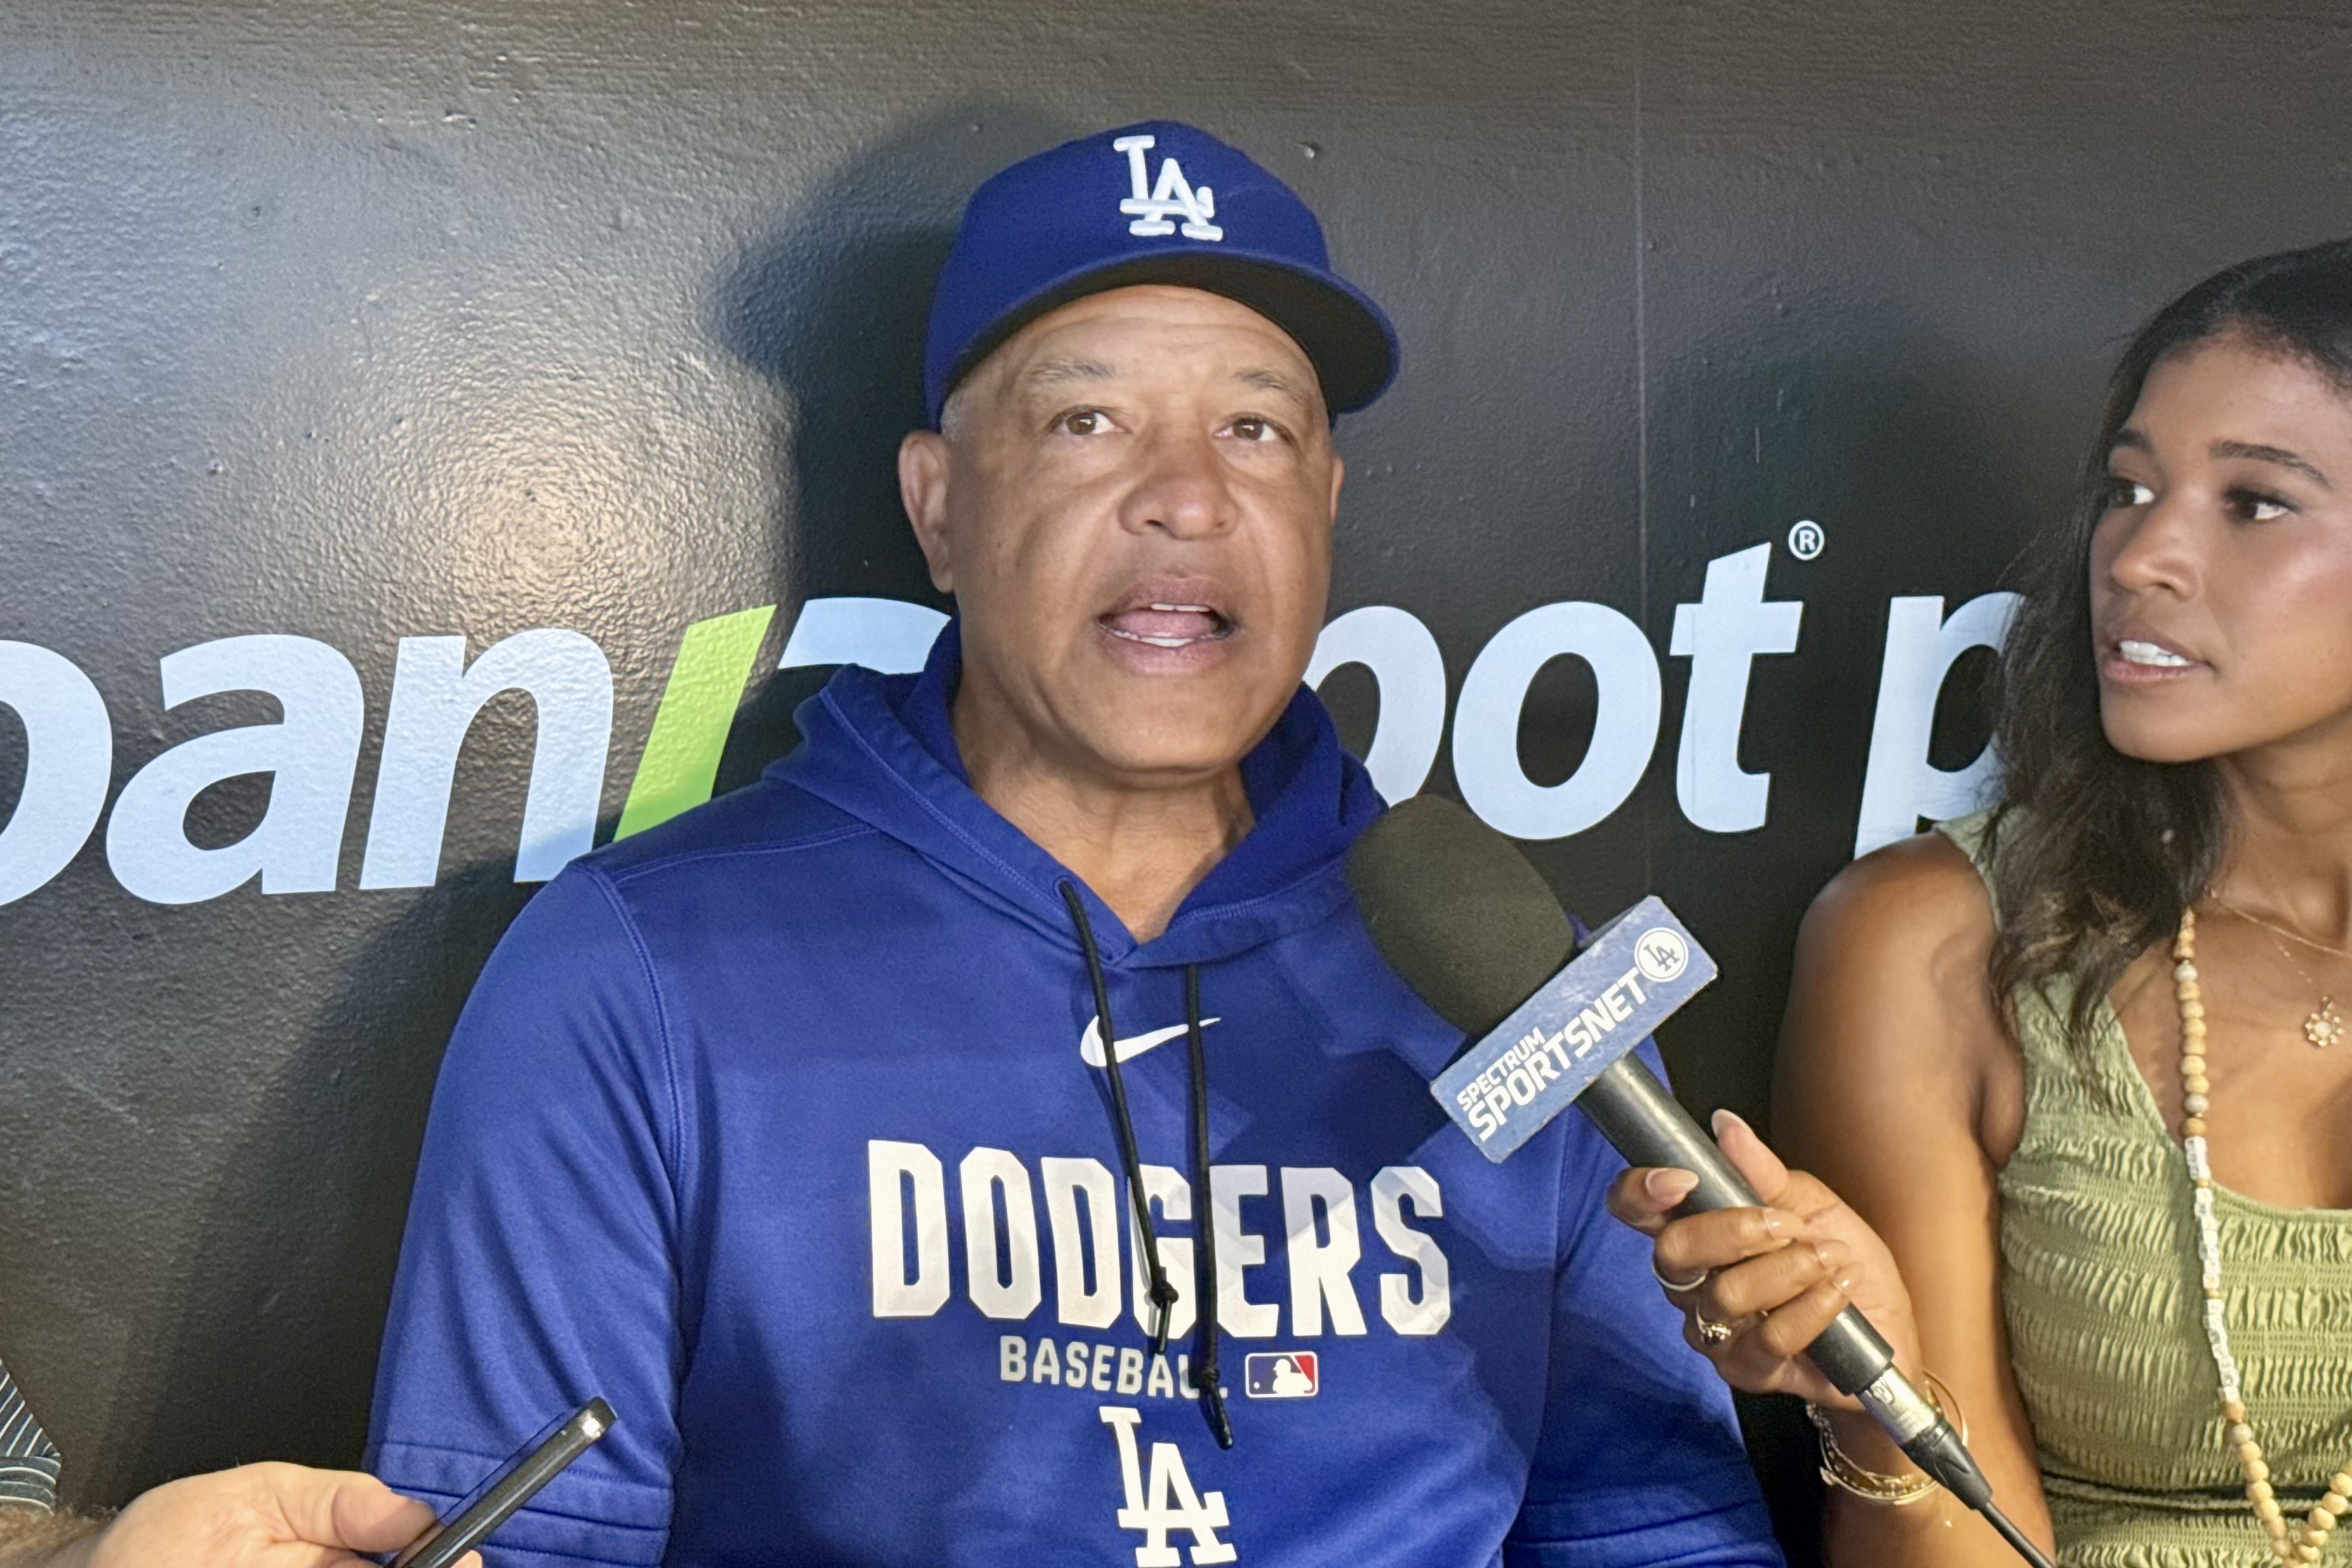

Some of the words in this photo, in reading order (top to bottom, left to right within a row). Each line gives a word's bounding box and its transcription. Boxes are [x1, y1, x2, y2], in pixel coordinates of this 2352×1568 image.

[1114, 135, 1223, 241] LA
[1643, 944, 1681, 972] LA
[1457, 1027, 1545, 1111] SPECTRUM
[1469, 967, 1646, 1141] SPORTSNET
[868, 1139, 1450, 1339] DODGERS
[1000, 1335, 1228, 1399] BASEBAL
[1100, 1406, 1237, 1568] LA
